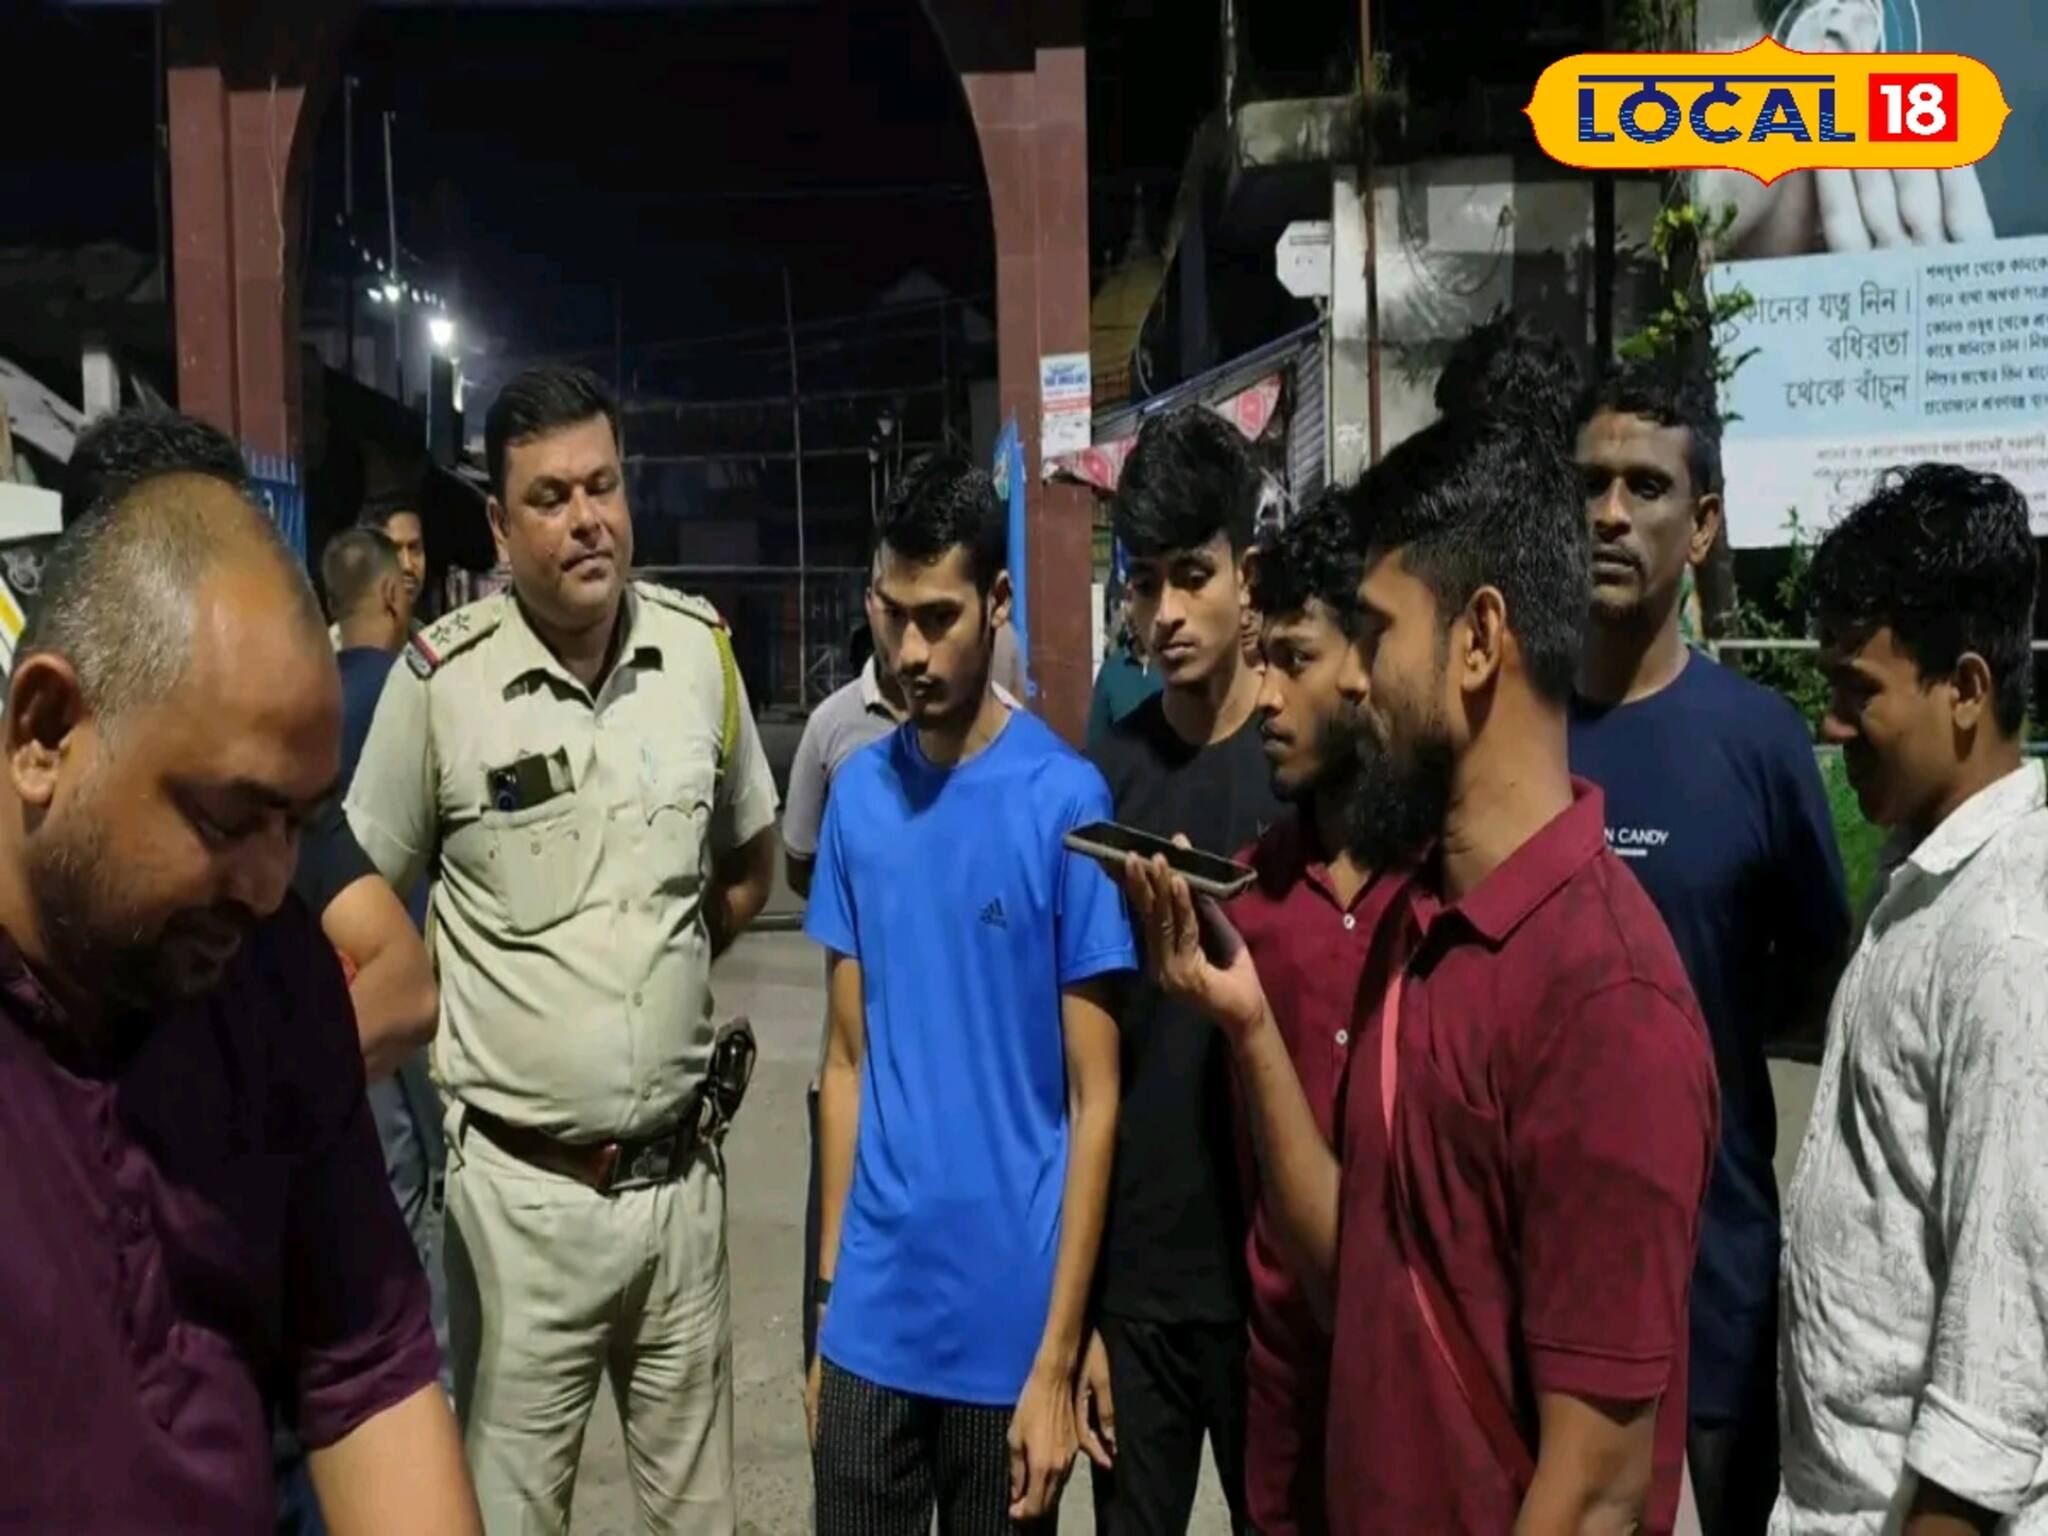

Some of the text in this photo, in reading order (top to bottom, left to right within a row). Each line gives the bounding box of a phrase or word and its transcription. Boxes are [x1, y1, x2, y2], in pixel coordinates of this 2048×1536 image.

[1826, 325, 1909, 360] বধিরতা
[1785, 368, 1909, 411] থেকে বাঁচুন
[1618, 828, 1669, 845] CANDY
